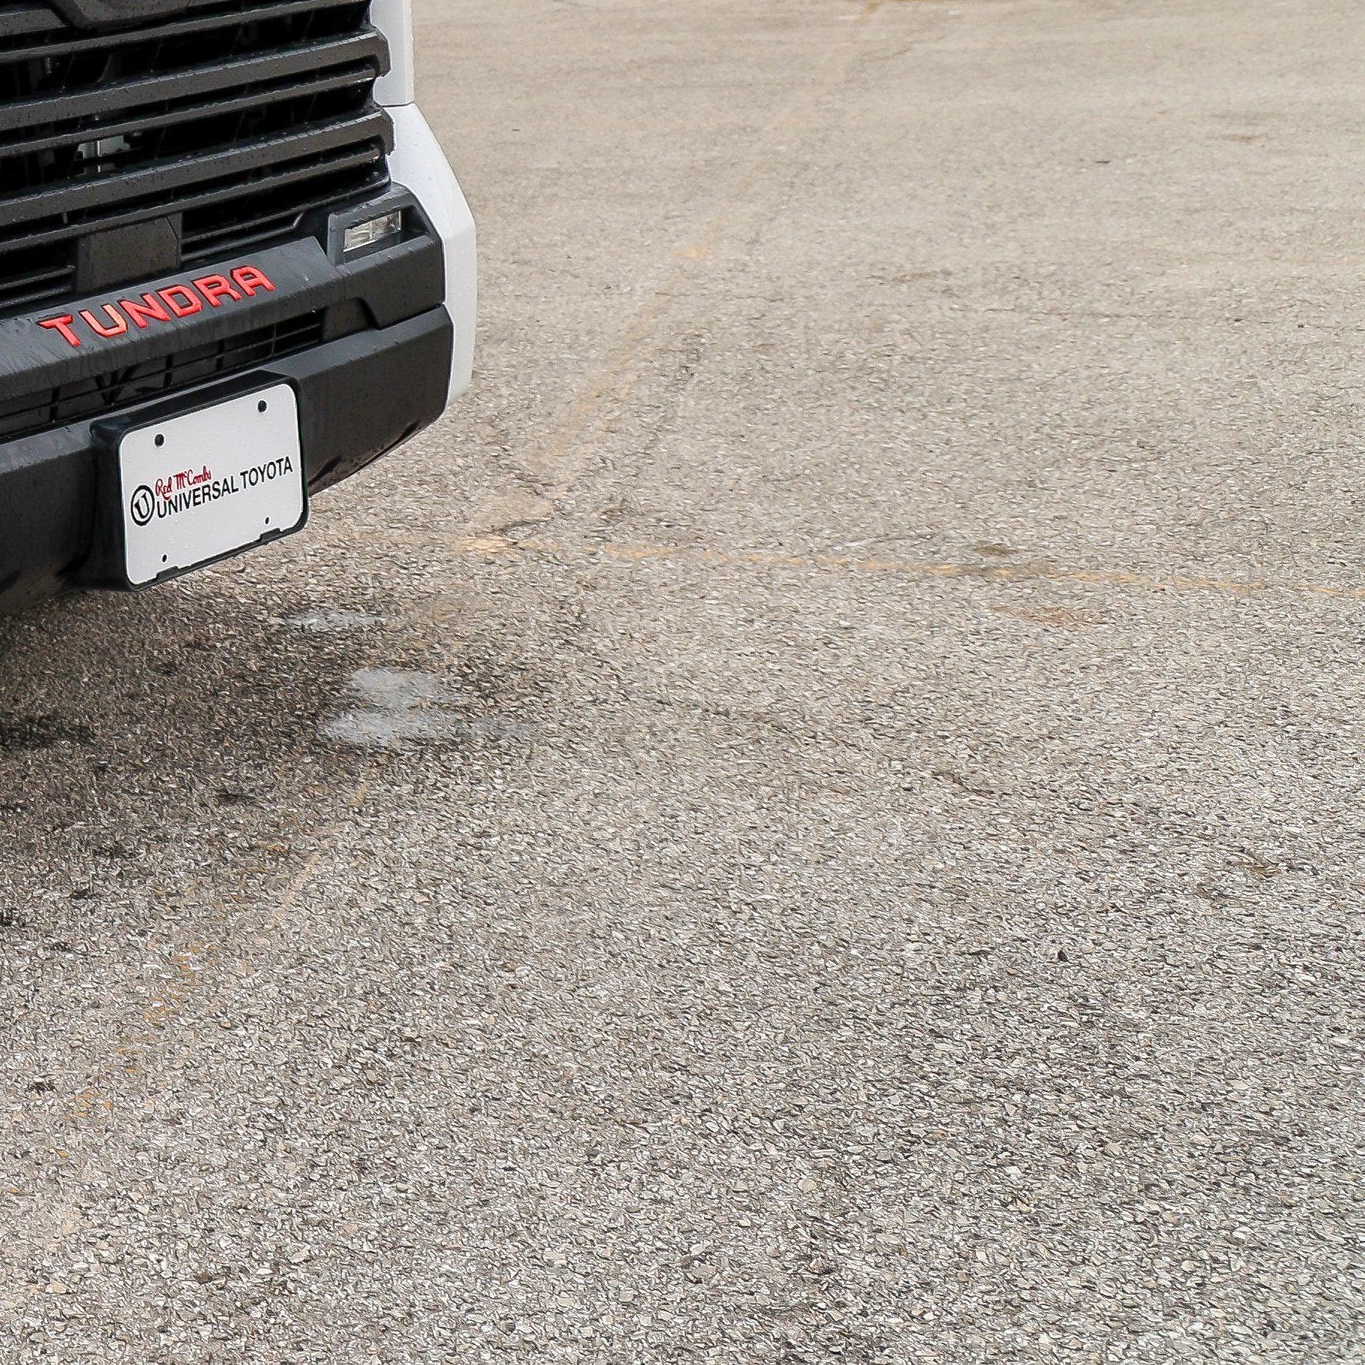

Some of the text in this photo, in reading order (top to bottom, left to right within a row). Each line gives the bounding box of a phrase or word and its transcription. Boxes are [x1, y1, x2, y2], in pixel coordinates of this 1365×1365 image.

[38, 265, 276, 347] TUNDRA
[155, 477, 172, 500] Red
[156, 456, 294, 519] UNIVERSAL TOYOTA
